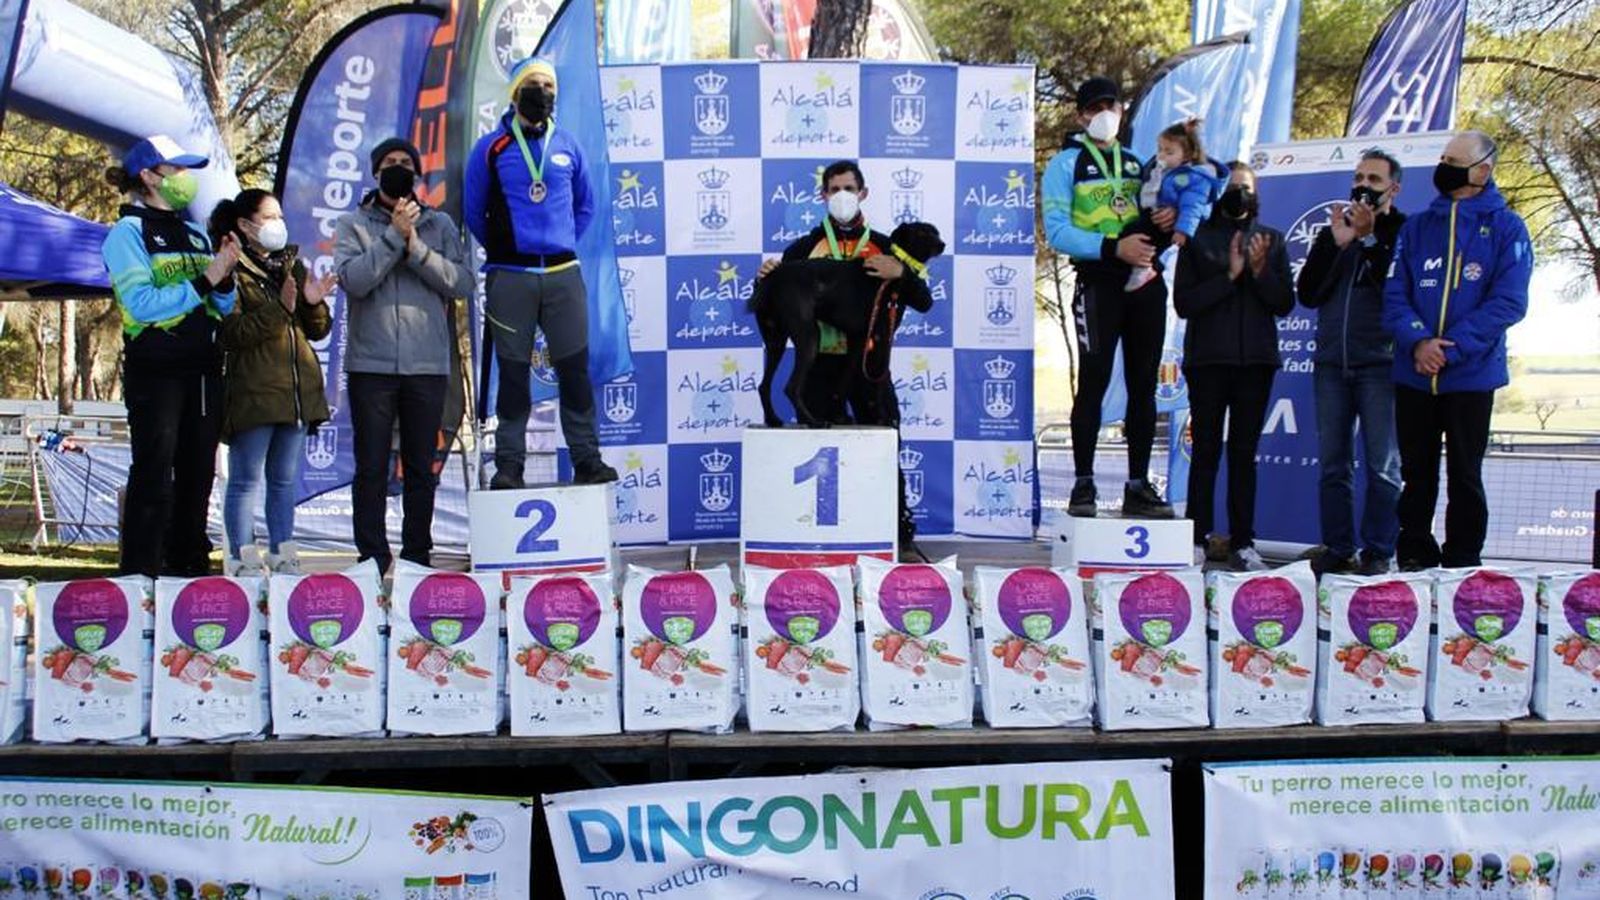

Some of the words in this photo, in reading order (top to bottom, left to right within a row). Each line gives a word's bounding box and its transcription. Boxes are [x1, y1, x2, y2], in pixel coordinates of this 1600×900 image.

[771, 85, 853, 108] Alcalá
[312, 55, 374, 238] deporte
[772, 130, 850, 150] deporte
[676, 279, 755, 301] Alcalá
[676, 321, 753, 342] deporte
[894, 321, 944, 340] porte
[678, 371, 758, 393] Alcalá
[893, 371, 948, 391] calá
[794, 447, 839, 526] 1
[514, 500, 560, 553] 2
[1124, 525, 1151, 558] 3
[430, 586, 465, 598] LAMB
[439, 598, 468, 610] RICE
[1237, 775, 1263, 793] Tu
[1272, 776, 1332, 795] perro
[1340, 774, 1424, 790] merece
[1433, 771, 1453, 789] lo
[1461, 769, 1533, 791] mejor,
[36, 792, 124, 808] merece
[133, 792, 153, 811] lo
[162, 795, 236, 818] mejor,
[1289, 799, 1372, 815] merece
[1380, 795, 1530, 815] alimentación
[1541, 784, 1600, 813] Natu
[0, 815, 73, 832] erece
[81, 813, 230, 841] alimentación
[242, 813, 357, 845] Natural!
[567, 779, 1150, 865] DINGONATURA
